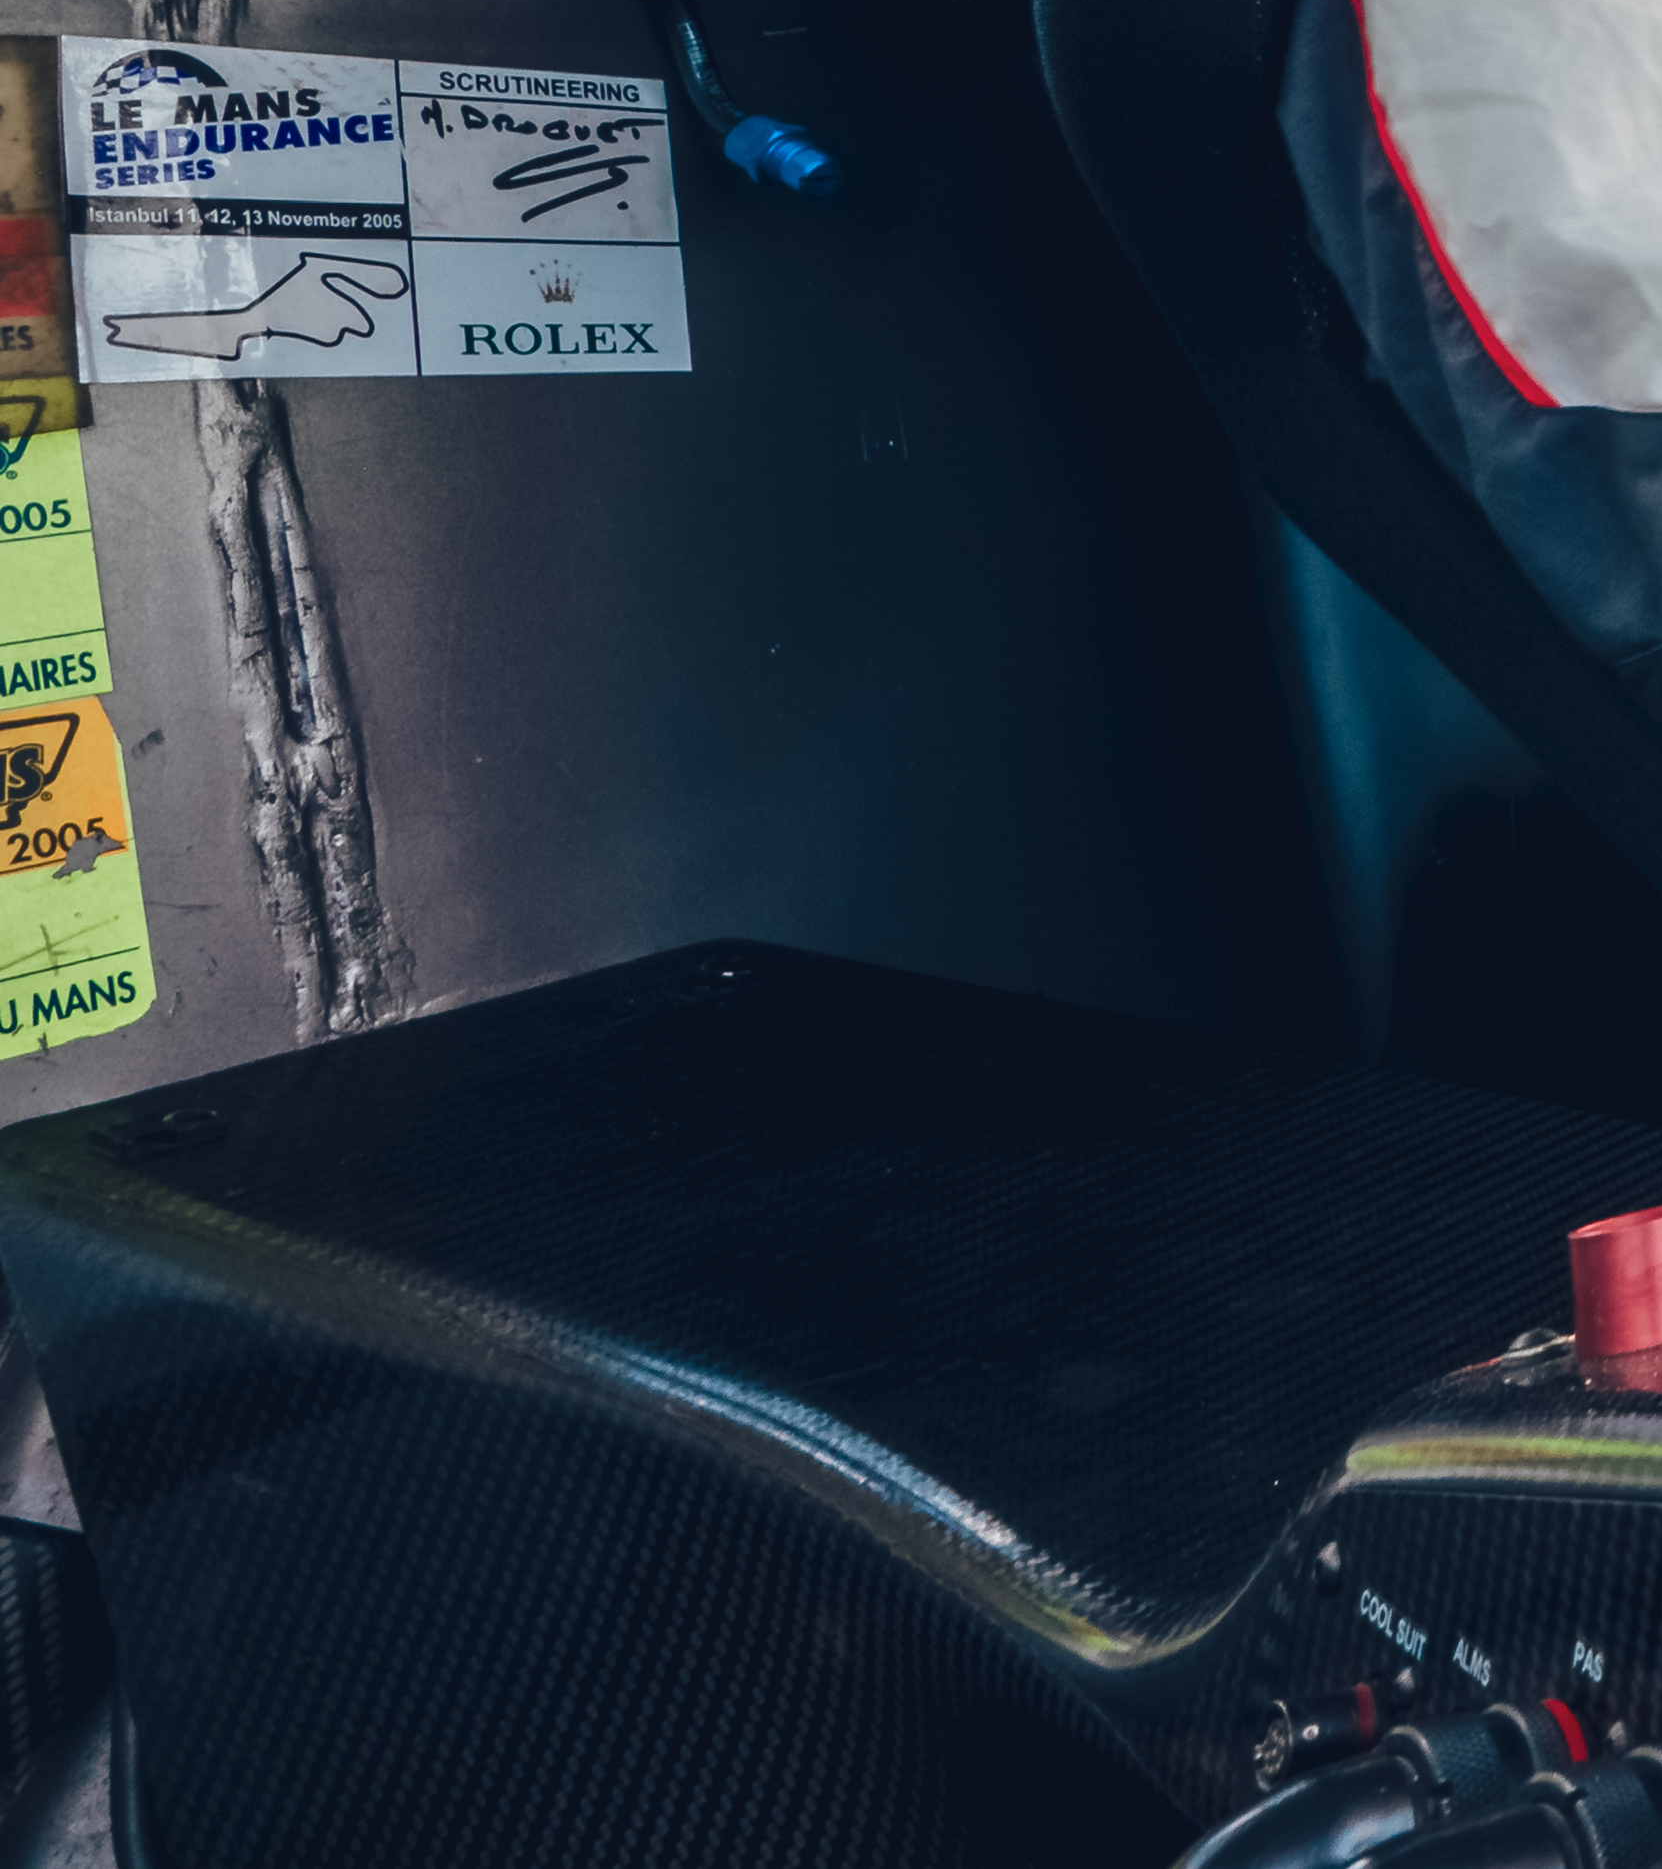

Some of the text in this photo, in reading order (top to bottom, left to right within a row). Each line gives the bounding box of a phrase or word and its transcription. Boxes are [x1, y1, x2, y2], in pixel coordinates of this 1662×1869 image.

[438, 71, 640, 103] SCRUTINEERING
[91, 89, 323, 131] LE MANS
[93, 113, 394, 165] ENDURANCE
[94, 158, 217, 190] SERIES
[89, 207, 168, 224] Istanbul
[209, 208, 236, 226] 12,
[242, 210, 264, 226] 13
[267, 211, 358, 228] November
[362, 213, 403, 230] 2005
[461, 322, 659, 358] ROLEX
[32, 970, 137, 1028] MANS
[1360, 1588, 1428, 1661] COOL SUIT
[1452, 1636, 1492, 1687] ALMS
[1572, 1639, 1605, 1683] PAS
